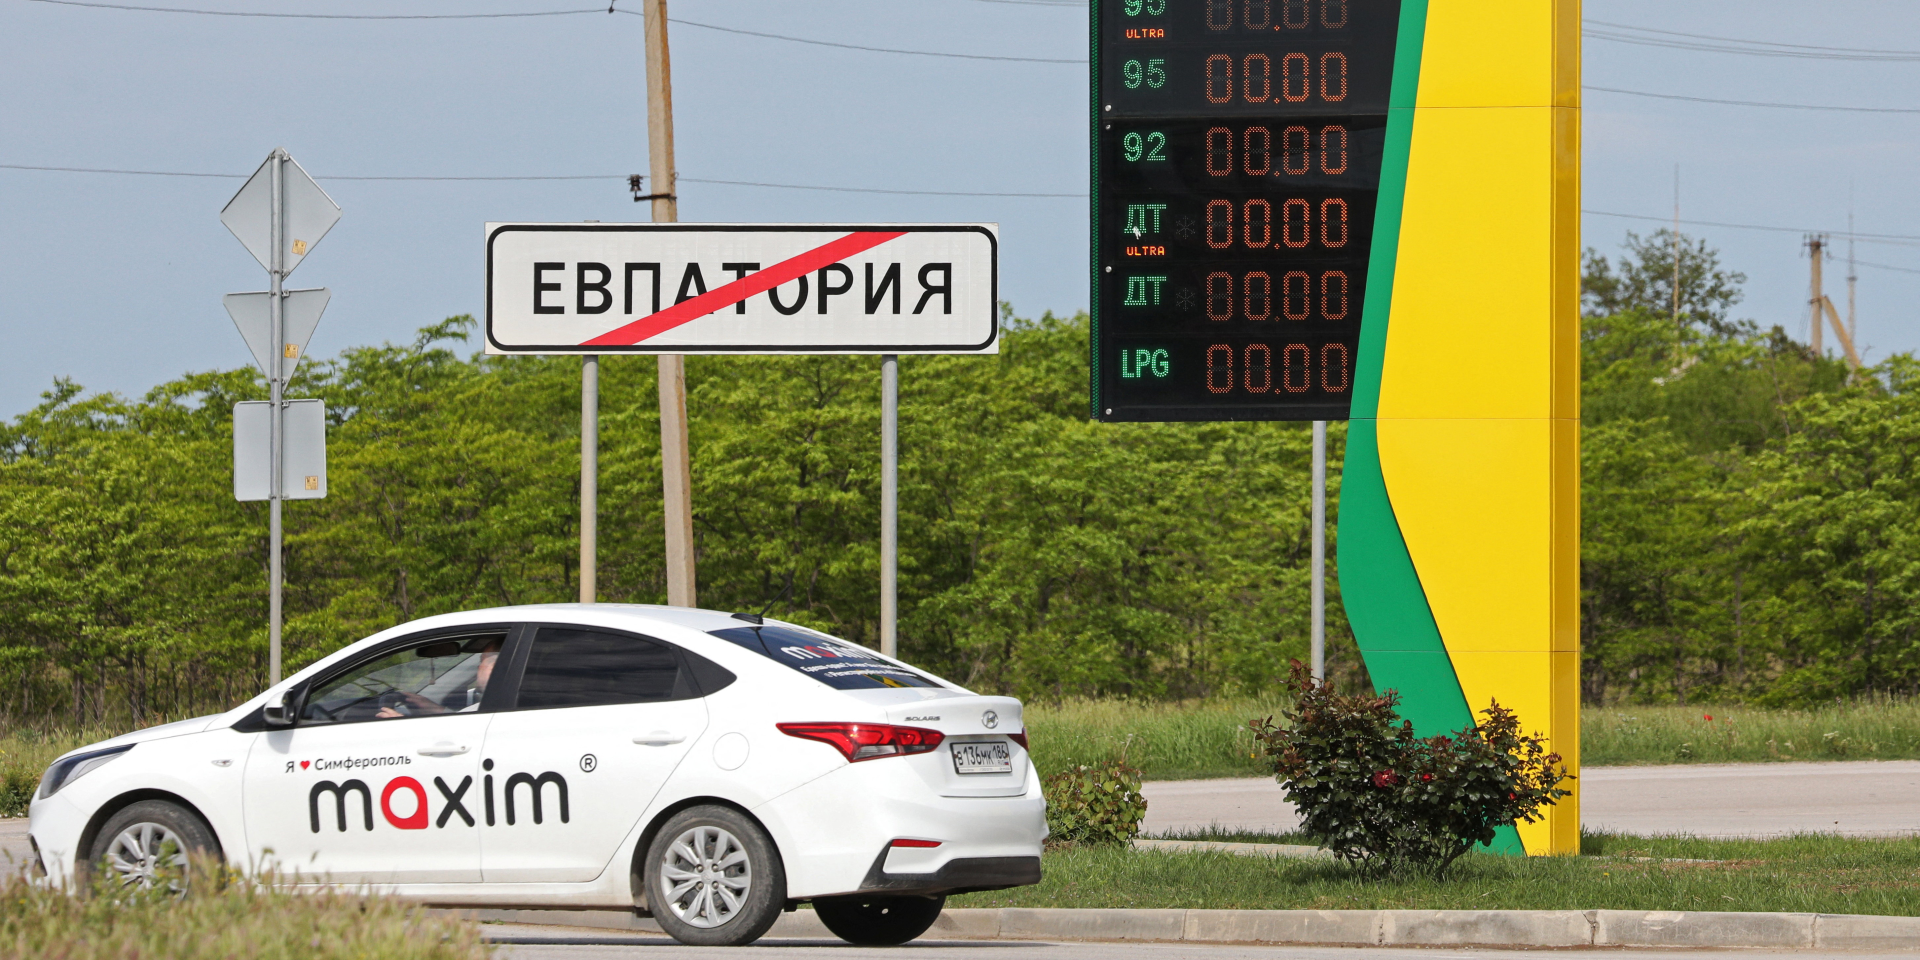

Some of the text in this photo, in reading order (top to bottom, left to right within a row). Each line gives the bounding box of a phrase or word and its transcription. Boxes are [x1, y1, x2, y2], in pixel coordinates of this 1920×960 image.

[1126, 28, 1165, 39] ULTRA
[1123, 58, 1166, 89] 95
[1206, 52, 1347, 104] 00.00
[1123, 131, 1166, 162] 92
[1206, 125, 1347, 177] 00.00
[1123, 204, 1167, 234] ДТ
[1206, 198, 1348, 250] 00.00
[1126, 246, 1165, 257] ULTRA
[533, 261, 953, 316] ЕВПАТОРИЯ
[1123, 276, 1167, 306] ДТ
[1206, 270, 1348, 322] 00.00
[1122, 349, 1169, 379] LPG
[1206, 343, 1348, 394] 00.00
[285, 754, 412, 773] Я Симферополь
[309, 758, 570, 834] maxim
